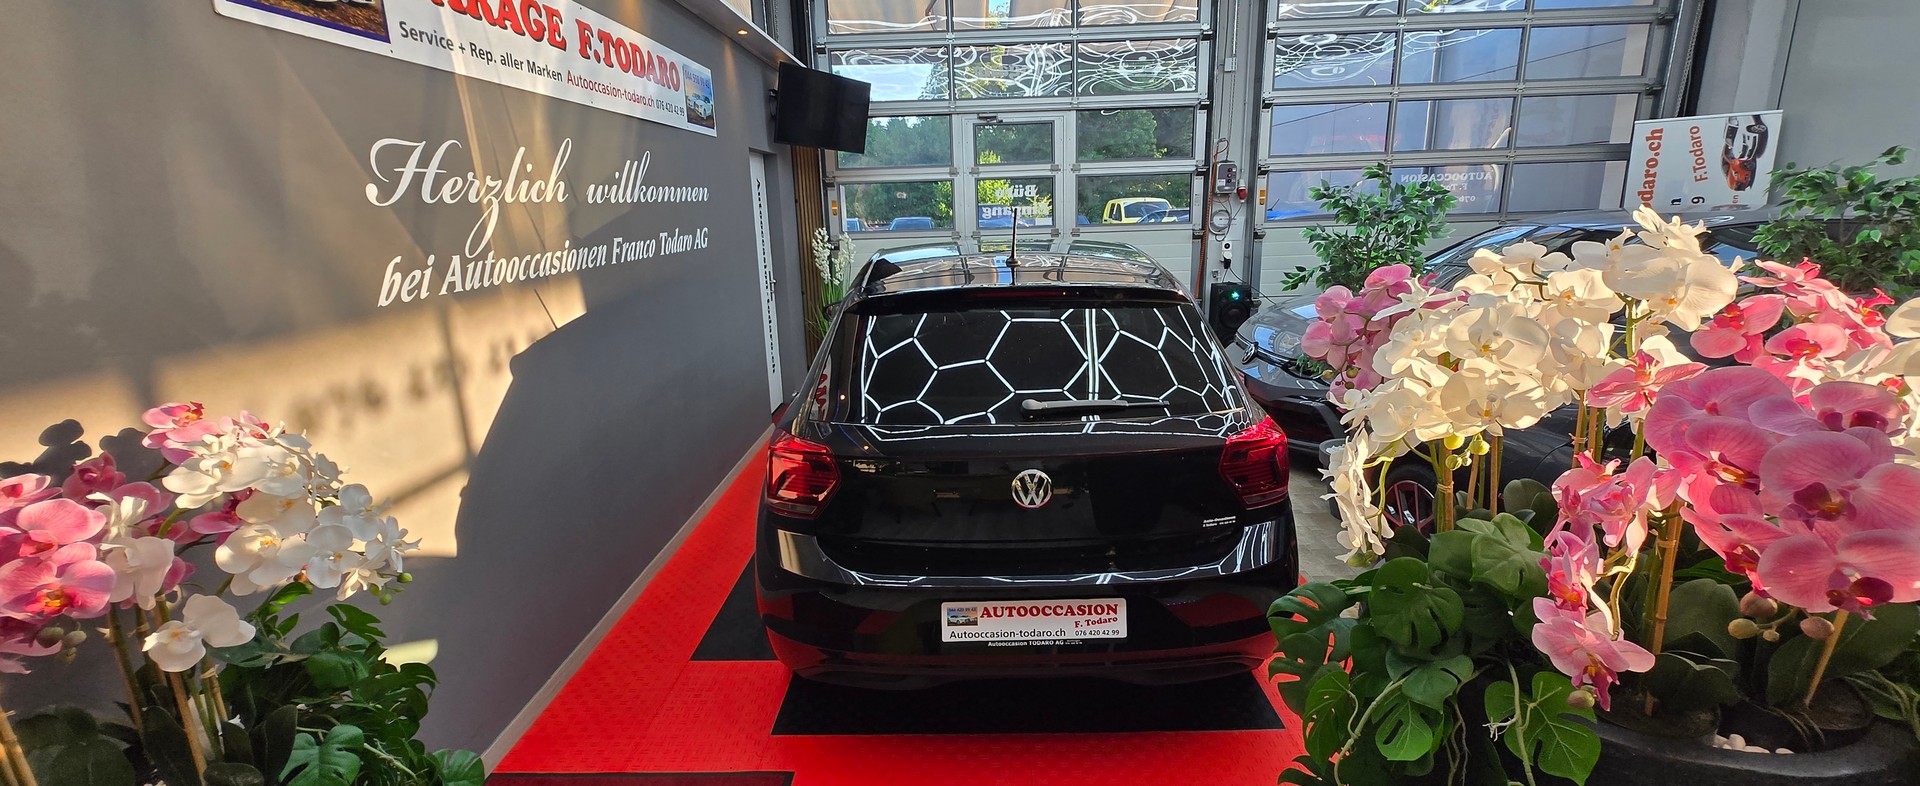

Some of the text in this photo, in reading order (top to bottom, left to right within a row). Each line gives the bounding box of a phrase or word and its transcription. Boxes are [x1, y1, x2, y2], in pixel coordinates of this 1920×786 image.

[399, 21, 454, 51] Service
[469, 42, 497, 65] Rep.
[500, 52, 524, 71] aller
[527, 60, 562, 82] Marken
[567, 70, 655, 108] Autooccasion-todaro.ch
[656, 98, 664, 110] 076
[665, 101, 674, 113] 420
[674, 104, 680, 115] 42
[680, 106, 685, 116] 99
[575, 18, 681, 92] F.TODARO
[365, 138, 709, 258] Herzlich willkommen
[377, 227, 709, 307] bei Autooccasionen Franco Todaro AG
[949, 628, 1066, 639] Autooccasion-todaro.ch
[980, 603, 1118, 618] AUTOOCCASION
[1085, 616, 1118, 626] Todaro
